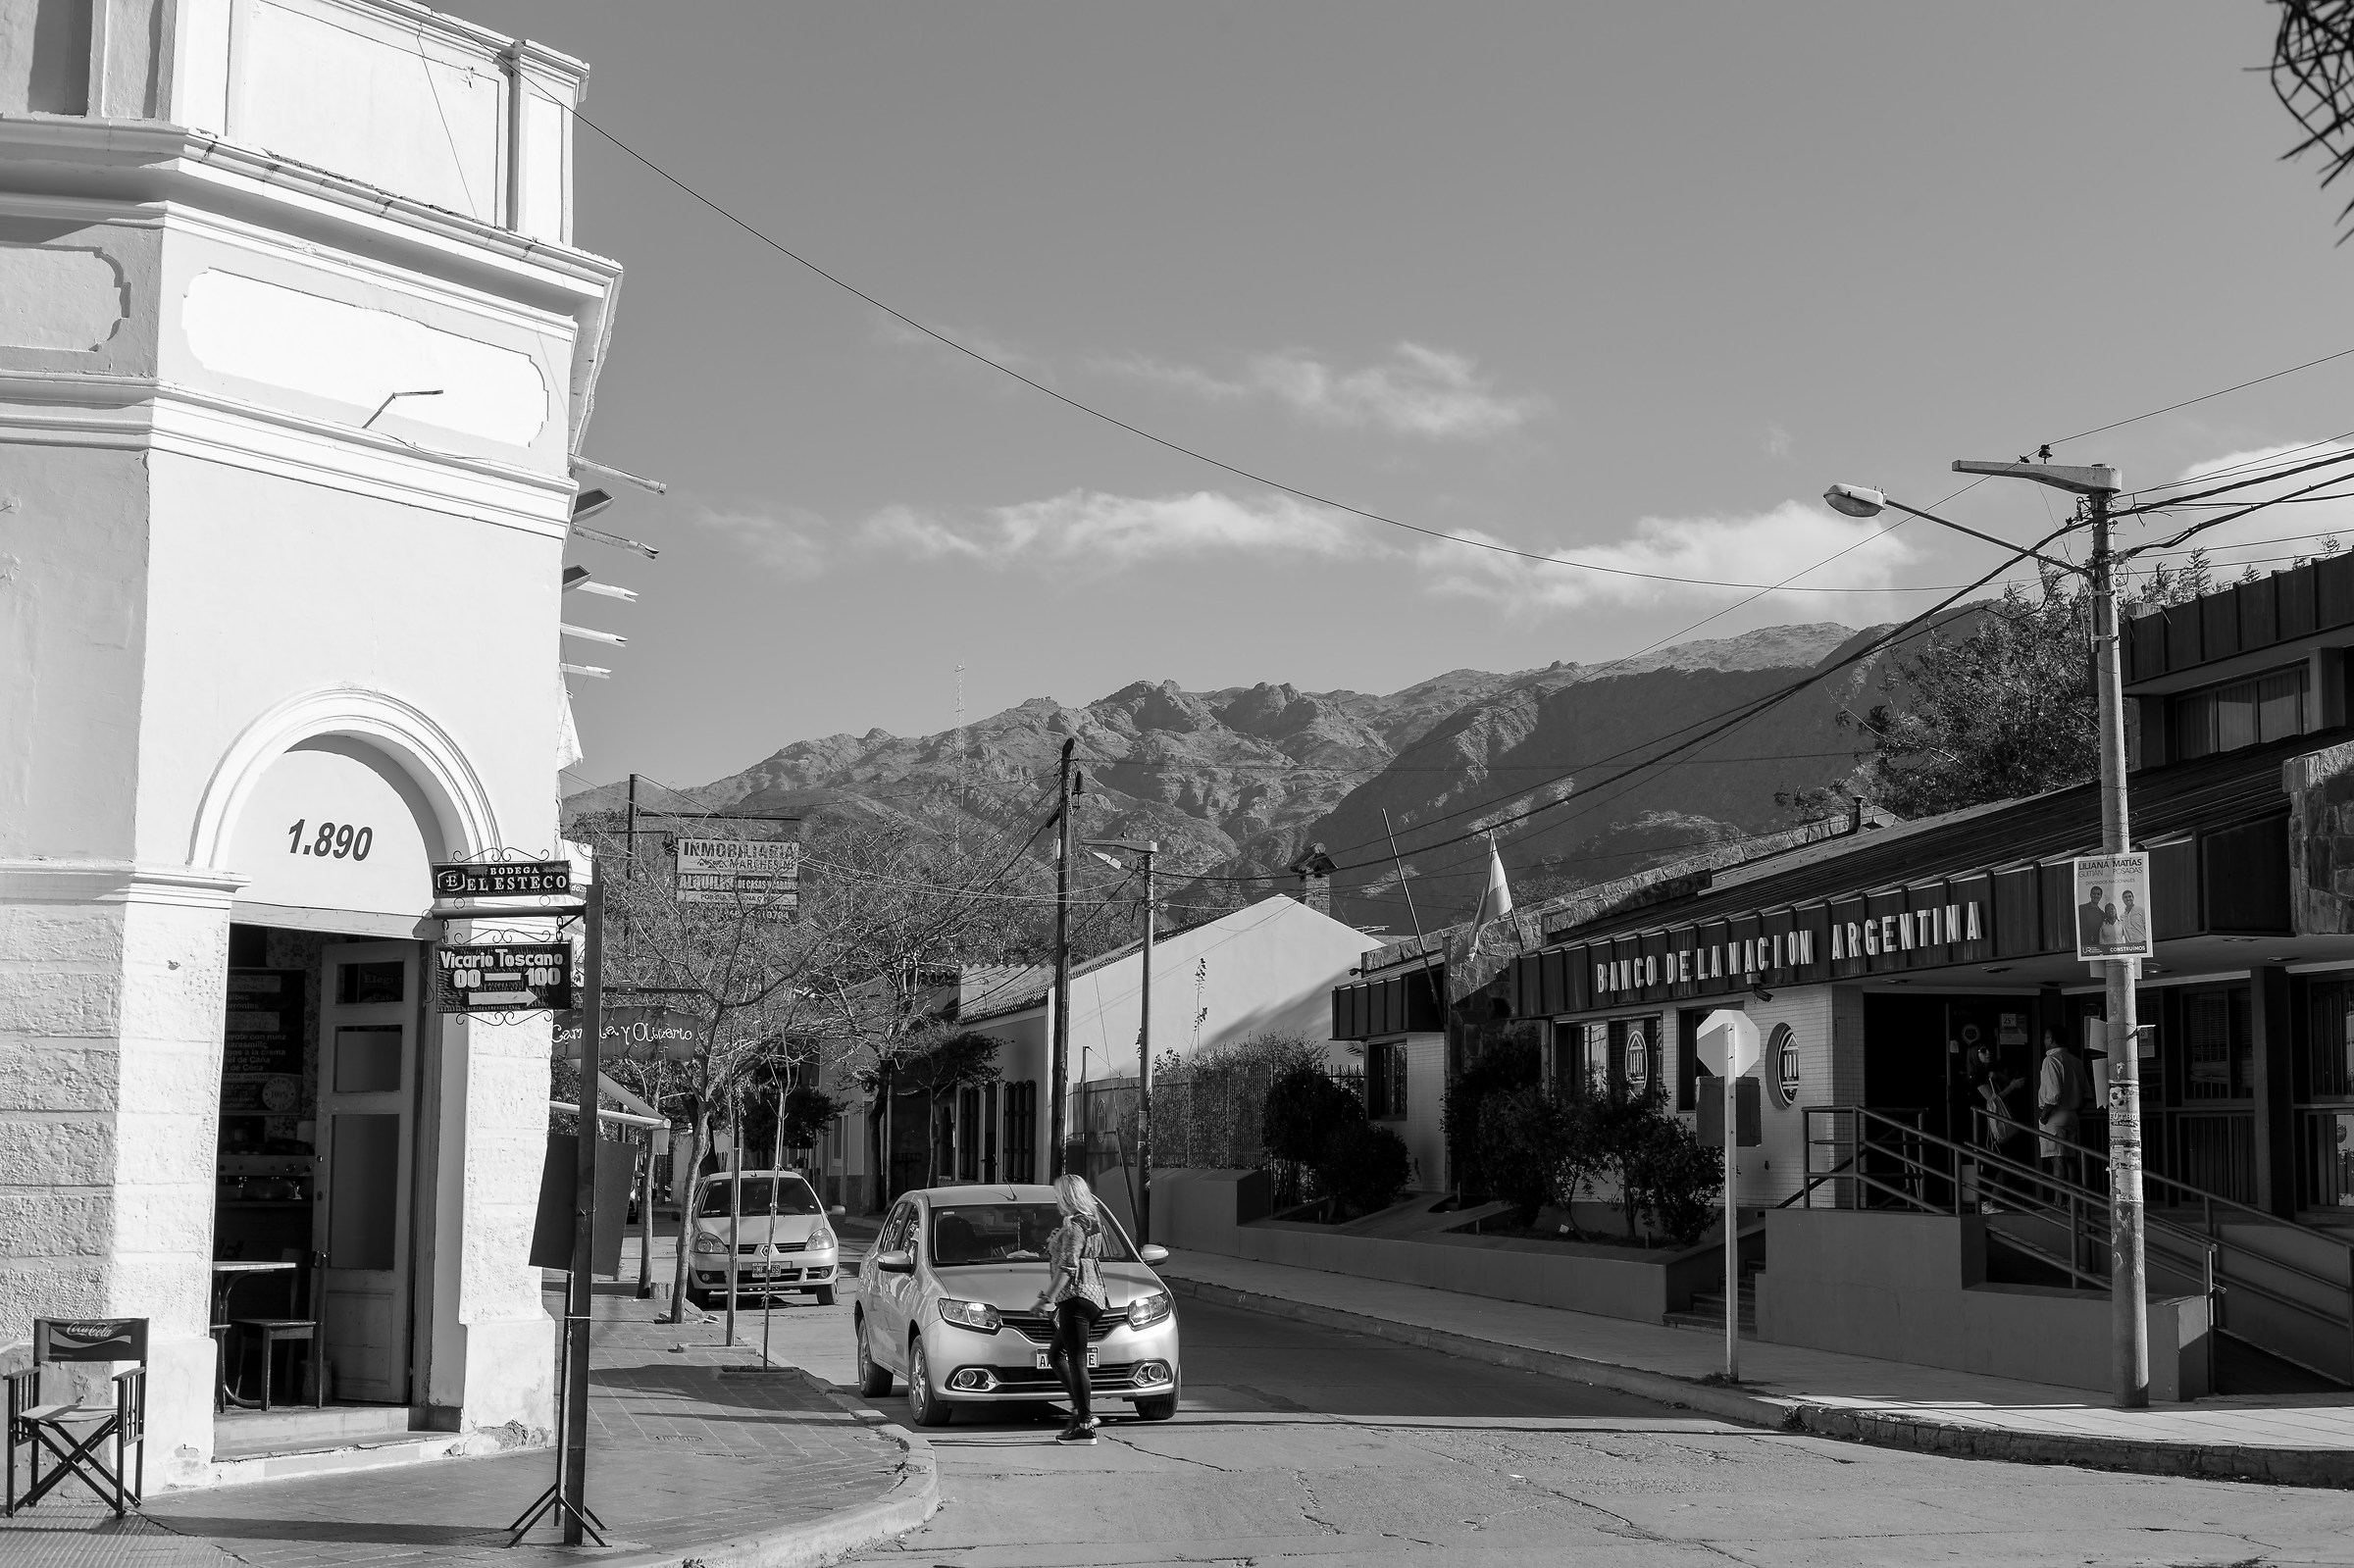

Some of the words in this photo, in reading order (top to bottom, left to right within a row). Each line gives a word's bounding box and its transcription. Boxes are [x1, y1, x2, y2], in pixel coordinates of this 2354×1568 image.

[288, 818, 373, 861] 1.890
[489, 867, 539, 876] BODEGA
[2078, 861, 2109, 871] LILIANA
[2112, 857, 2142, 868] MATÍAS
[466, 878, 488, 891] EL
[493, 875, 567, 891] ESTECO
[1597, 955, 1658, 993] BANCO
[1666, 949, 1693, 985] DE
[1697, 944, 1722, 981] LA
[1728, 930, 1815, 976] NACION
[1832, 901, 1983, 961] ARGENTINA
[439, 950, 494, 969] Vicario
[494, 948, 564, 968] Toscano
[453, 969, 481, 988] 00
[525, 967, 561, 987] 100
[227, 992, 250, 1001] albec
[551, 1024, 620, 1043] Camla
